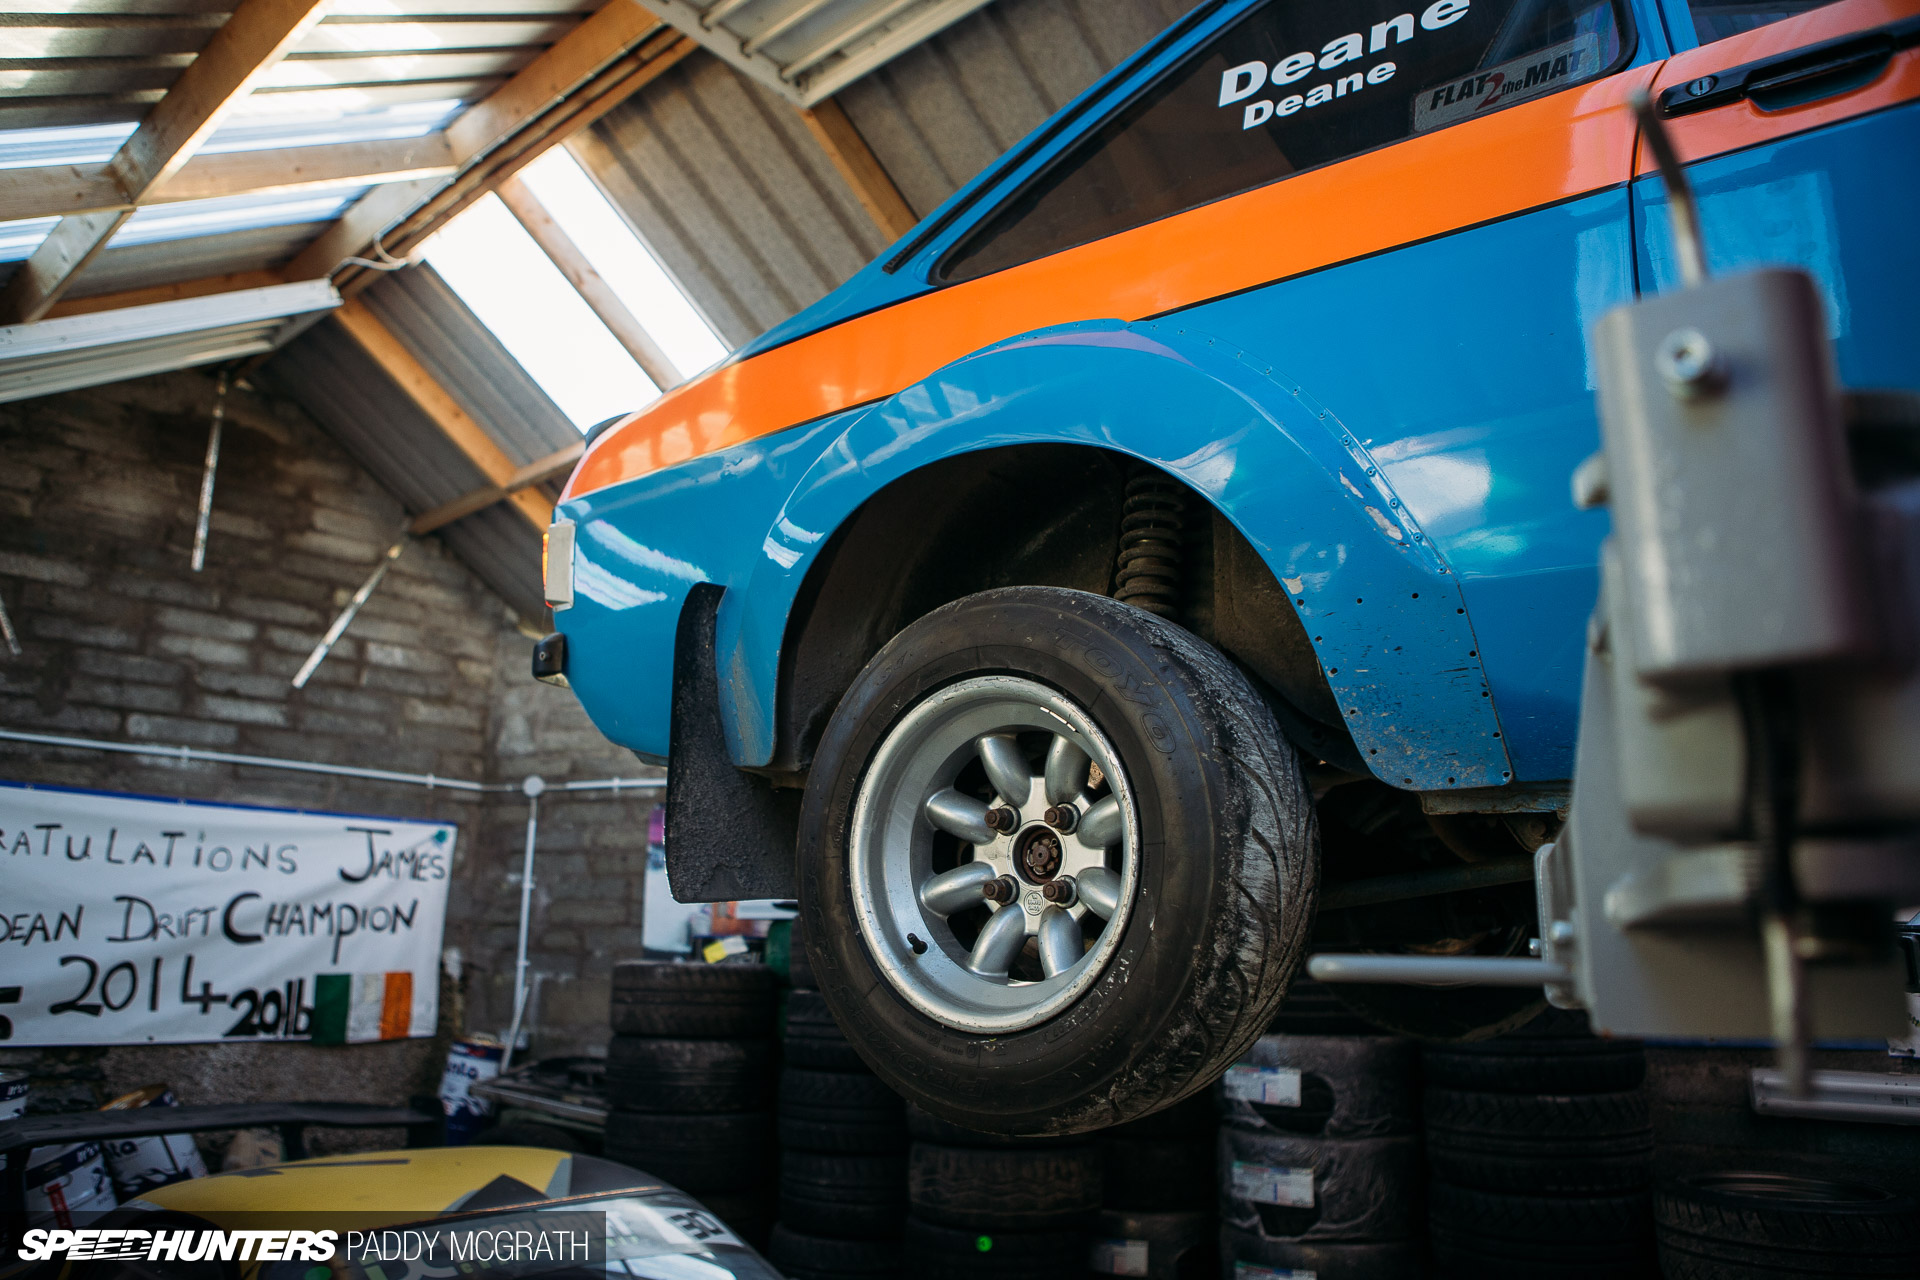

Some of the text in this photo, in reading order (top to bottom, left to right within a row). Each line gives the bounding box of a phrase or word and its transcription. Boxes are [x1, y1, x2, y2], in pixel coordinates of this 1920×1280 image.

[1218, 0, 1470, 108] Deane
[1430, 72, 1491, 111] FLAT
[1524, 48, 1586, 89] MAT
[1243, 61, 1397, 131] Deane
[1055, 627, 1178, 753] TOYO
[339, 826, 446, 883] JAMES
[106, 895, 218, 944] DRIFT
[222, 892, 418, 966] CHAMPION
[49, 954, 228, 1016] 2014
